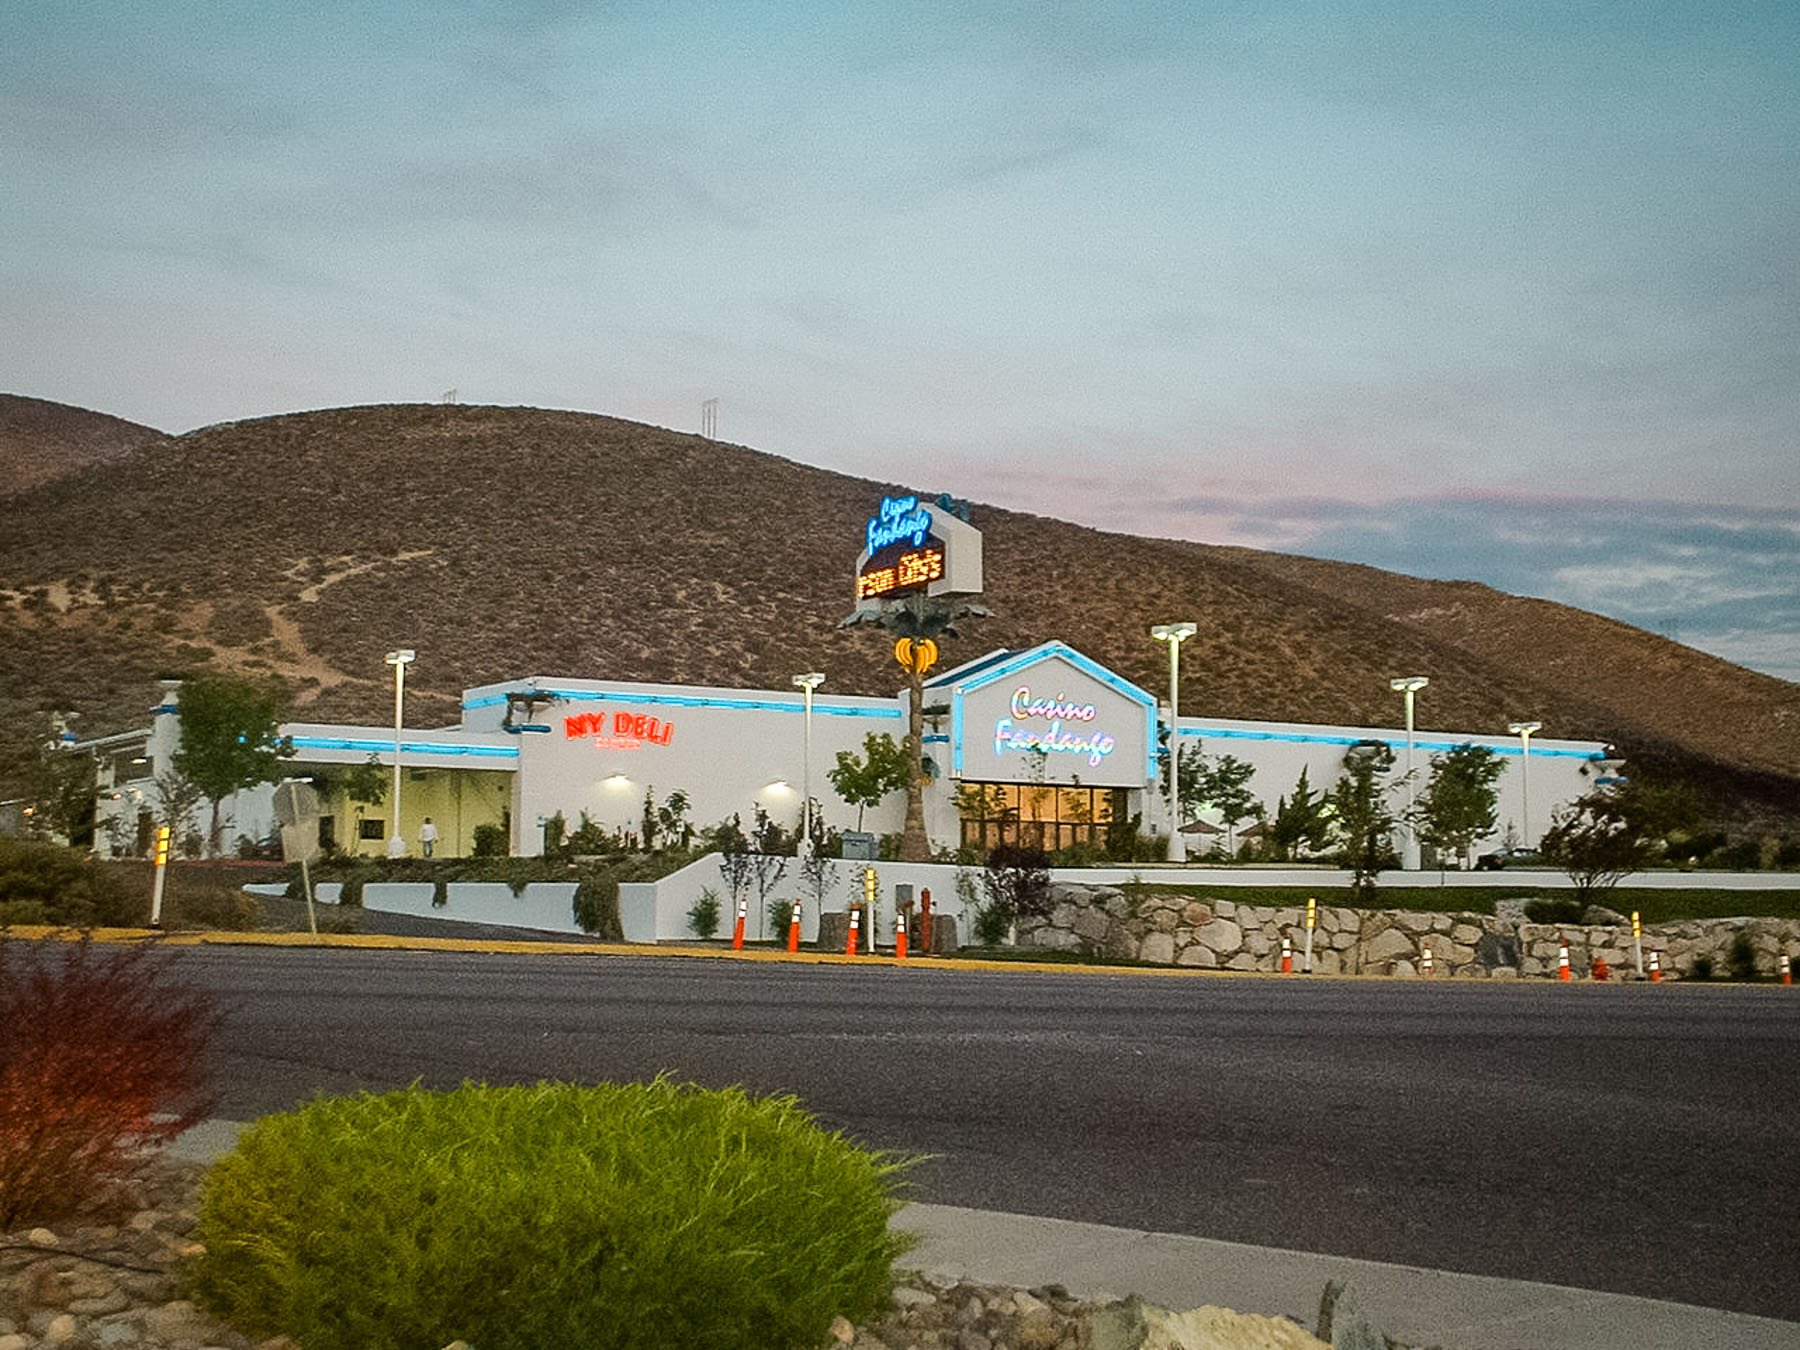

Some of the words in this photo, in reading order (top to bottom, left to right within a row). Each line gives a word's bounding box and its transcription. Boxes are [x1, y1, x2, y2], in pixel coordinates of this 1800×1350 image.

[1010, 685, 1097, 721] Casino
[564, 712, 606, 741] NY
[613, 710, 674, 746] DELI
[994, 717, 1116, 768] Fandango
